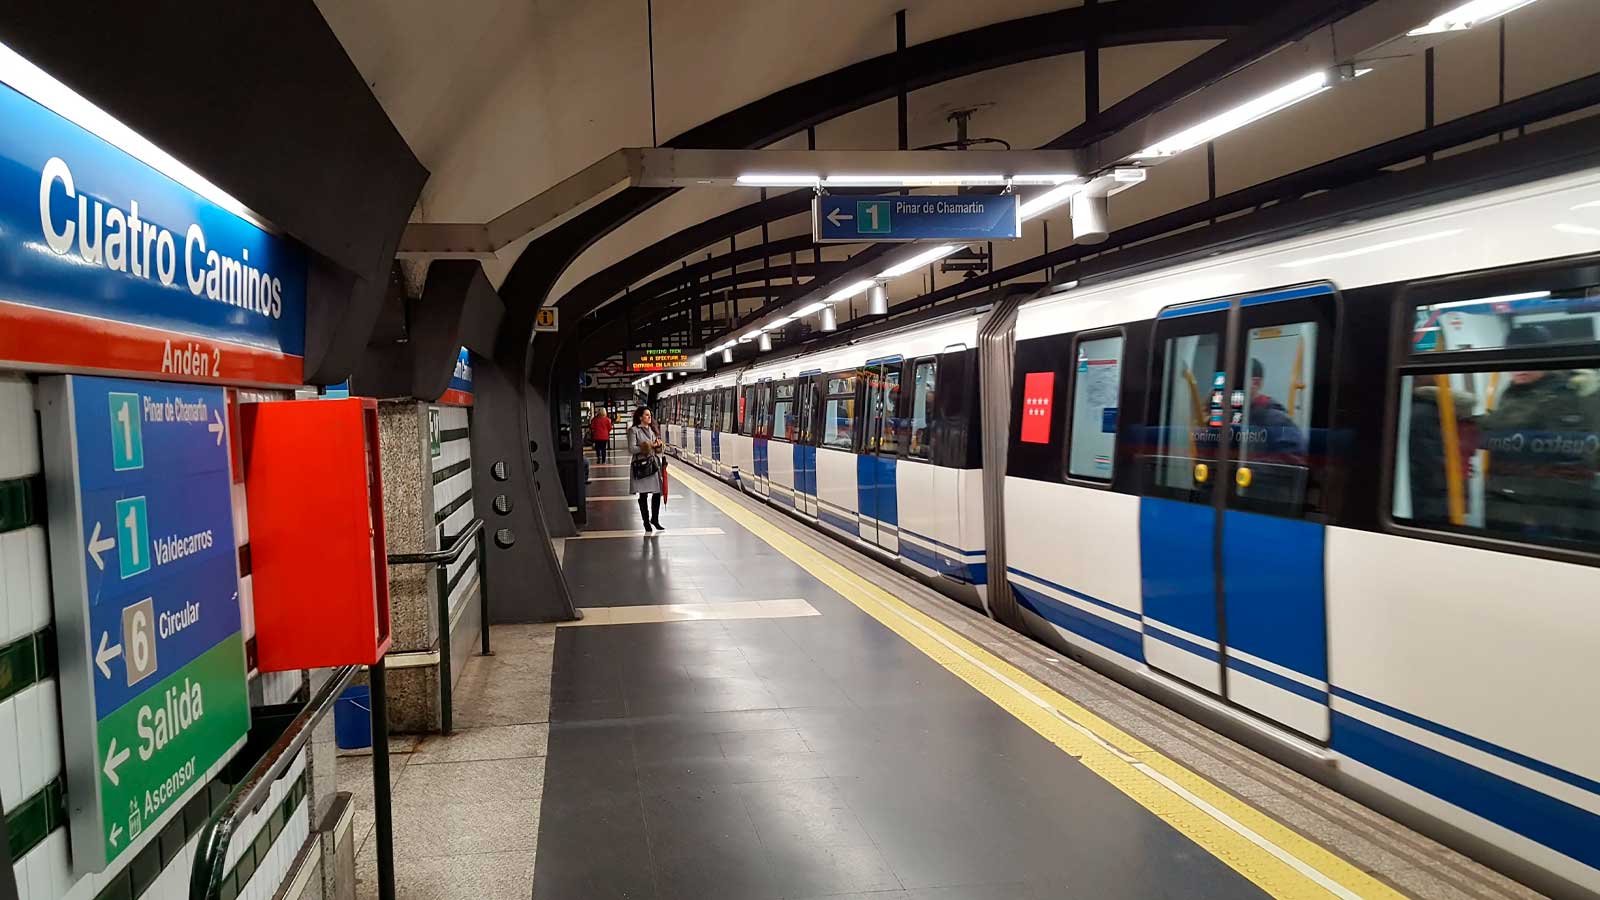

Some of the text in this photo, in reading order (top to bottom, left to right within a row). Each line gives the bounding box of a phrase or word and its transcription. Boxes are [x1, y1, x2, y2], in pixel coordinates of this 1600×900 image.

[40, 157, 282, 319] Cuatro Caminos
[866, 201, 984, 229] 1 Pinar de Chamartín
[162, 340, 220, 377] Andén 2
[118, 401, 132, 461] 1
[143, 395, 164, 422] Pinar
[165, 396, 174, 422] de
[125, 505, 213, 566] 1 Valdecarros
[132, 601, 200, 672] 6 Circular
[137, 677, 203, 762] Salida
[144, 756, 196, 820] Ascensor
